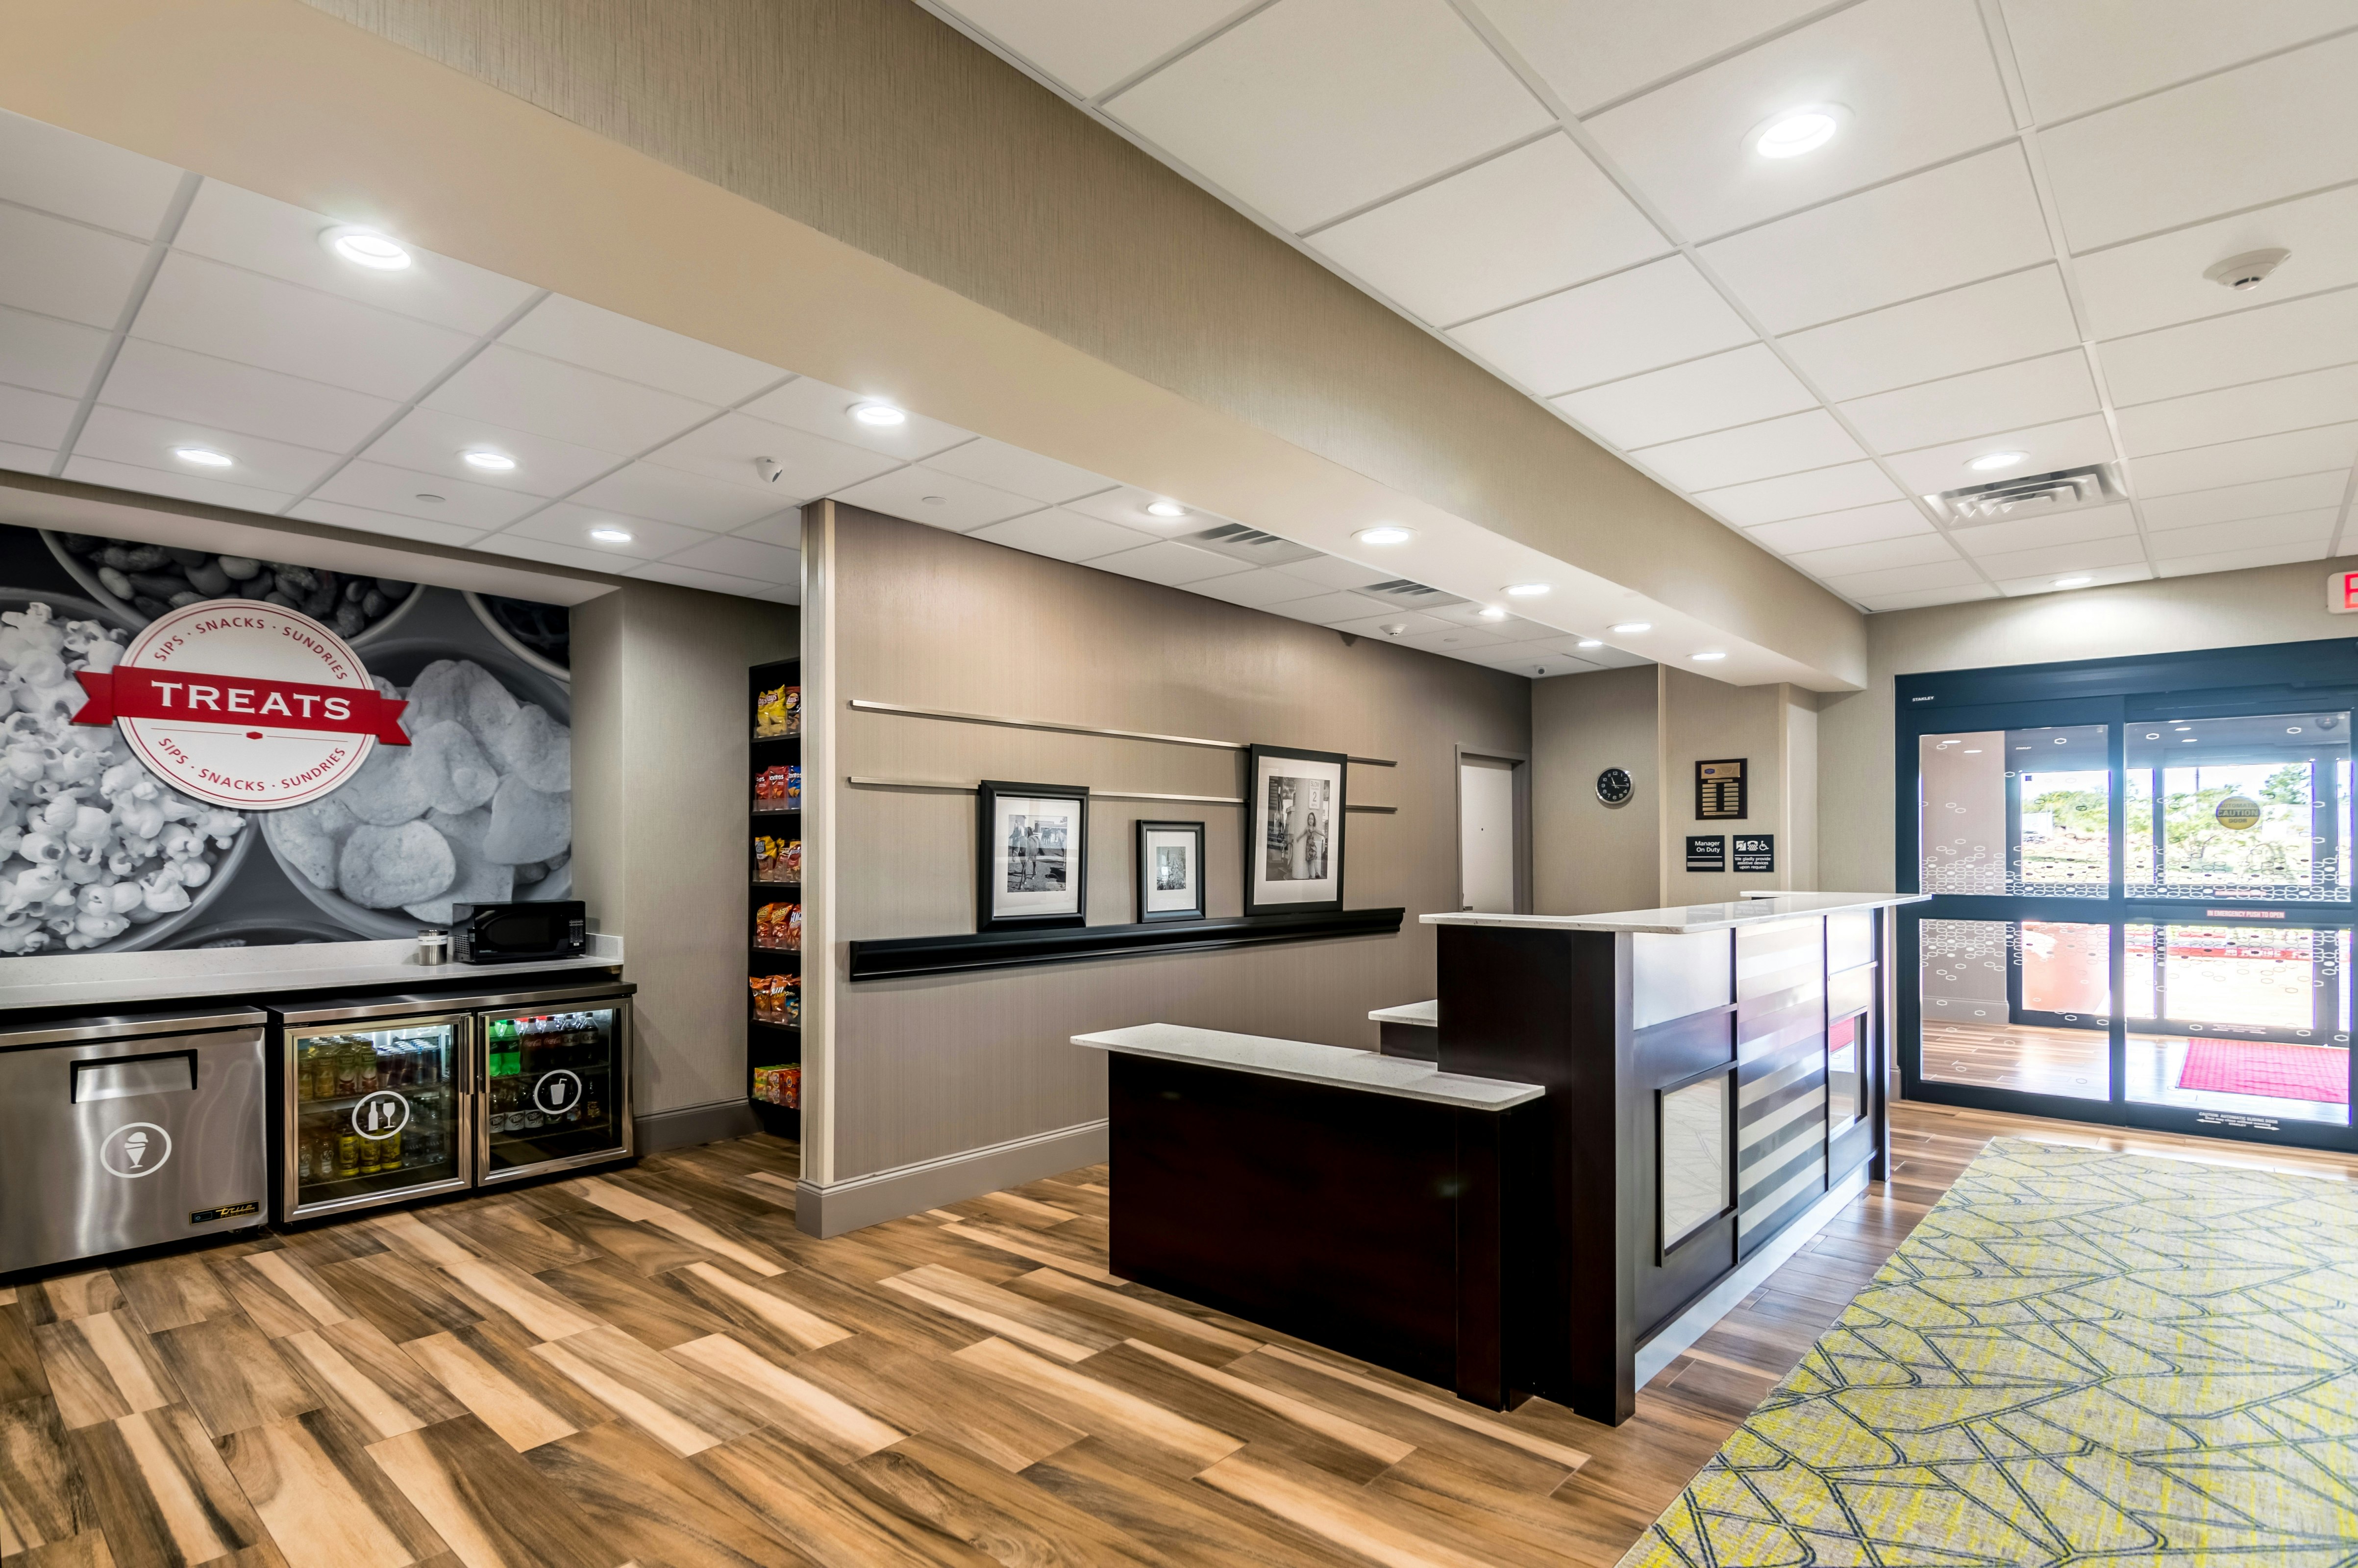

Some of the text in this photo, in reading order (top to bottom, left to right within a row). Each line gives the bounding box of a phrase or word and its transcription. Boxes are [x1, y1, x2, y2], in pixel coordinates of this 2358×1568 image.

[154, 617, 348, 681] SIPS SNACKS SUNDRIES
[150, 680, 351, 721] TREATS
[158, 737, 346, 792] SIPS SNACKS SUNDRIES
[1313, 791, 1317, 802] 2
